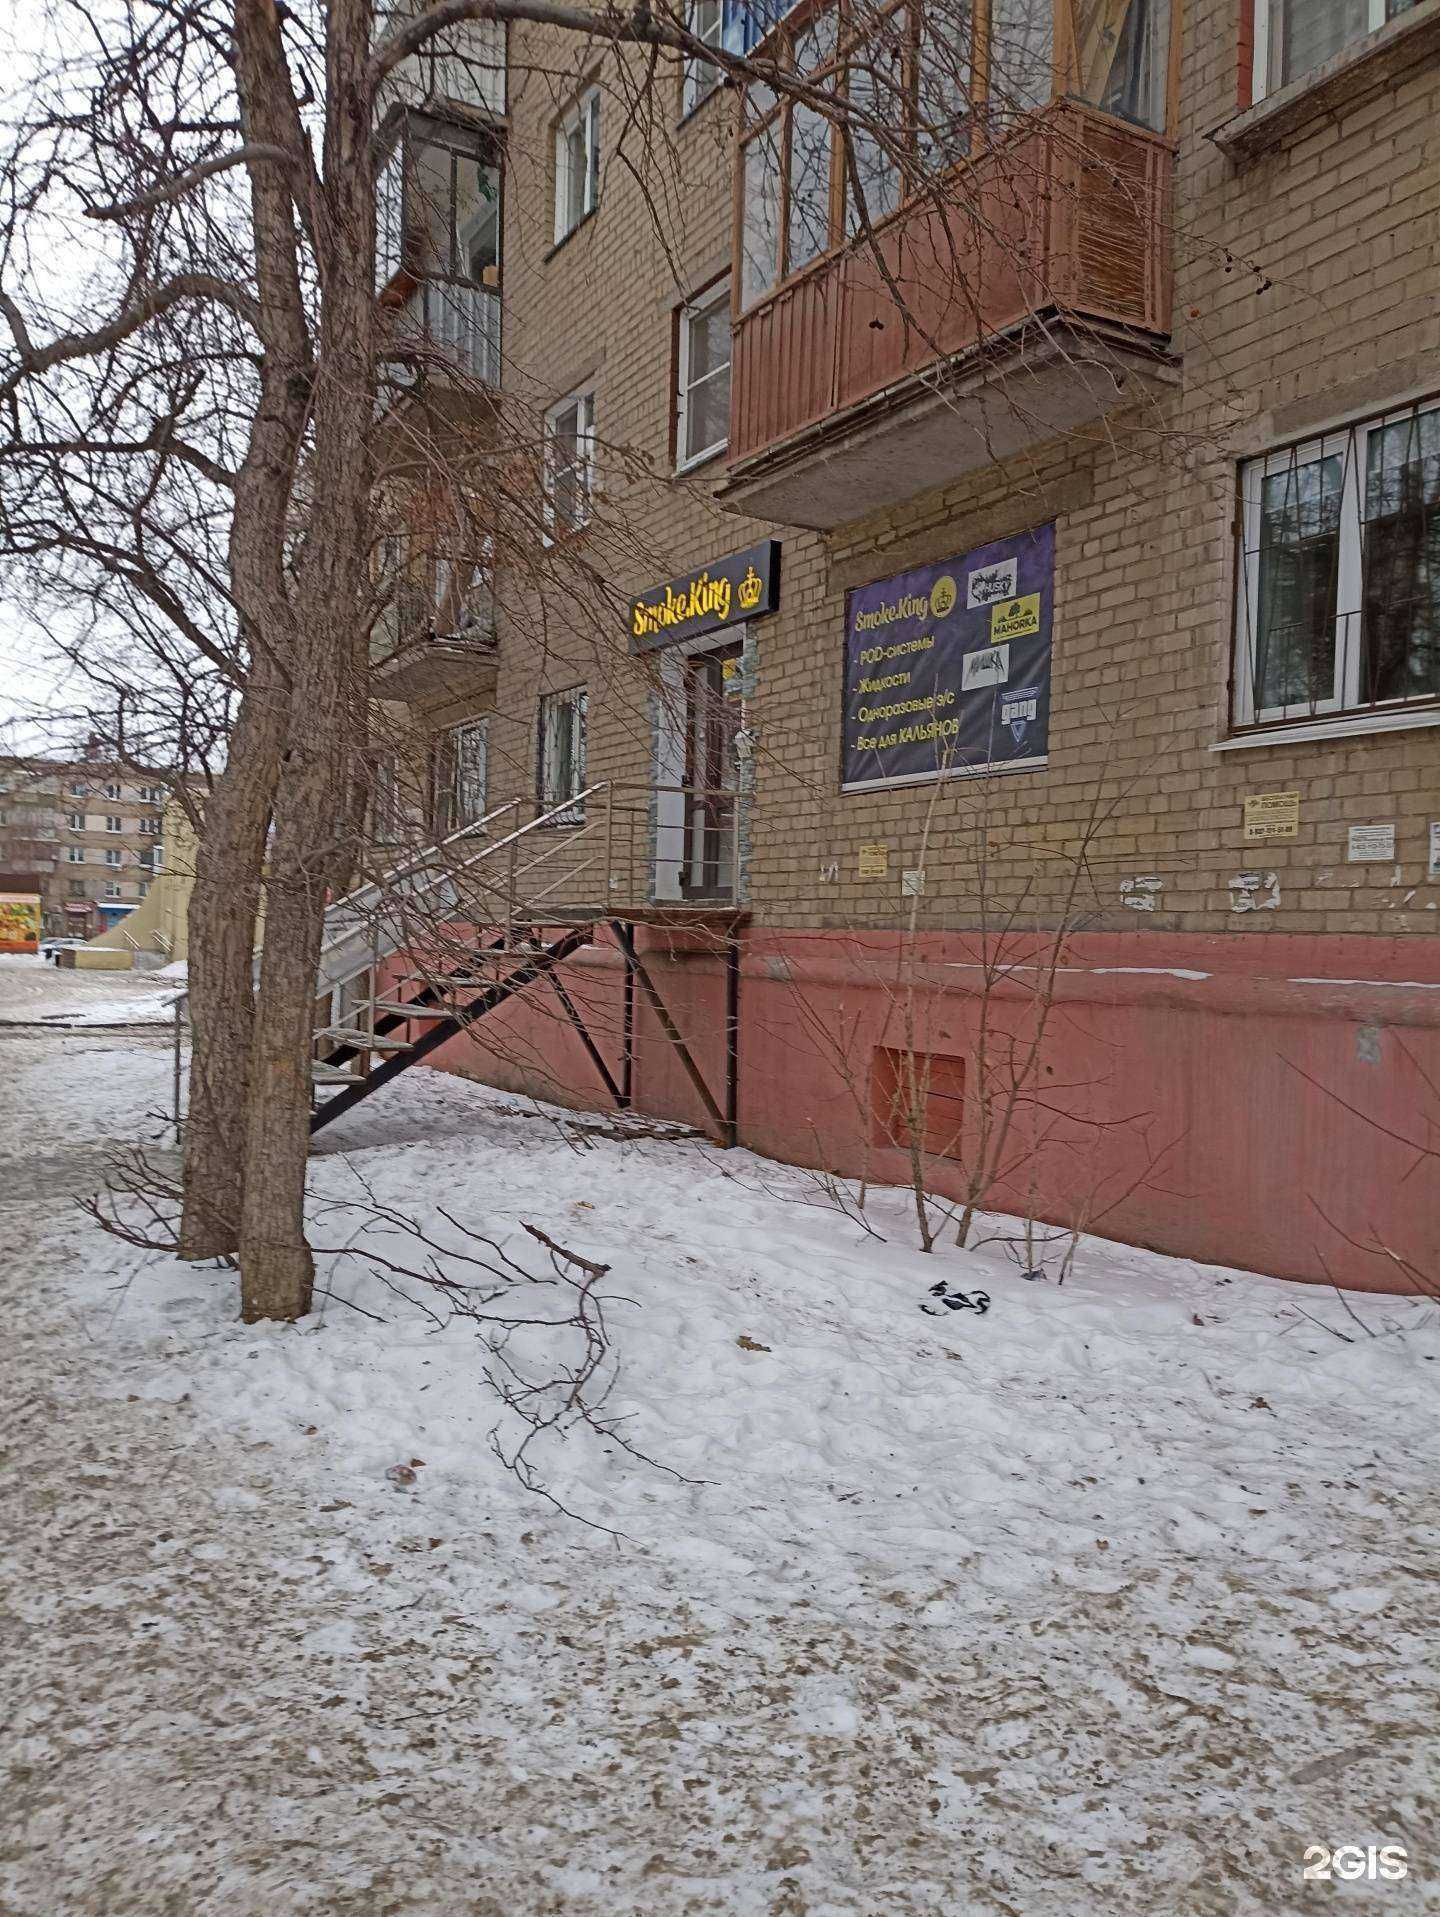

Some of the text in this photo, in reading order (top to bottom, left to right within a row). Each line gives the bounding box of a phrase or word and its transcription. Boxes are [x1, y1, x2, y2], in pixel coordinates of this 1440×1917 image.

[993, 616, 1037, 635] MAHORKA
[859, 672, 911, 694] Жидкости
[858, 696, 934, 722] Одноразовые
[1001, 699, 1037, 726] gang
[857, 718, 959, 751] Все для КАЛЬЯНОВ
